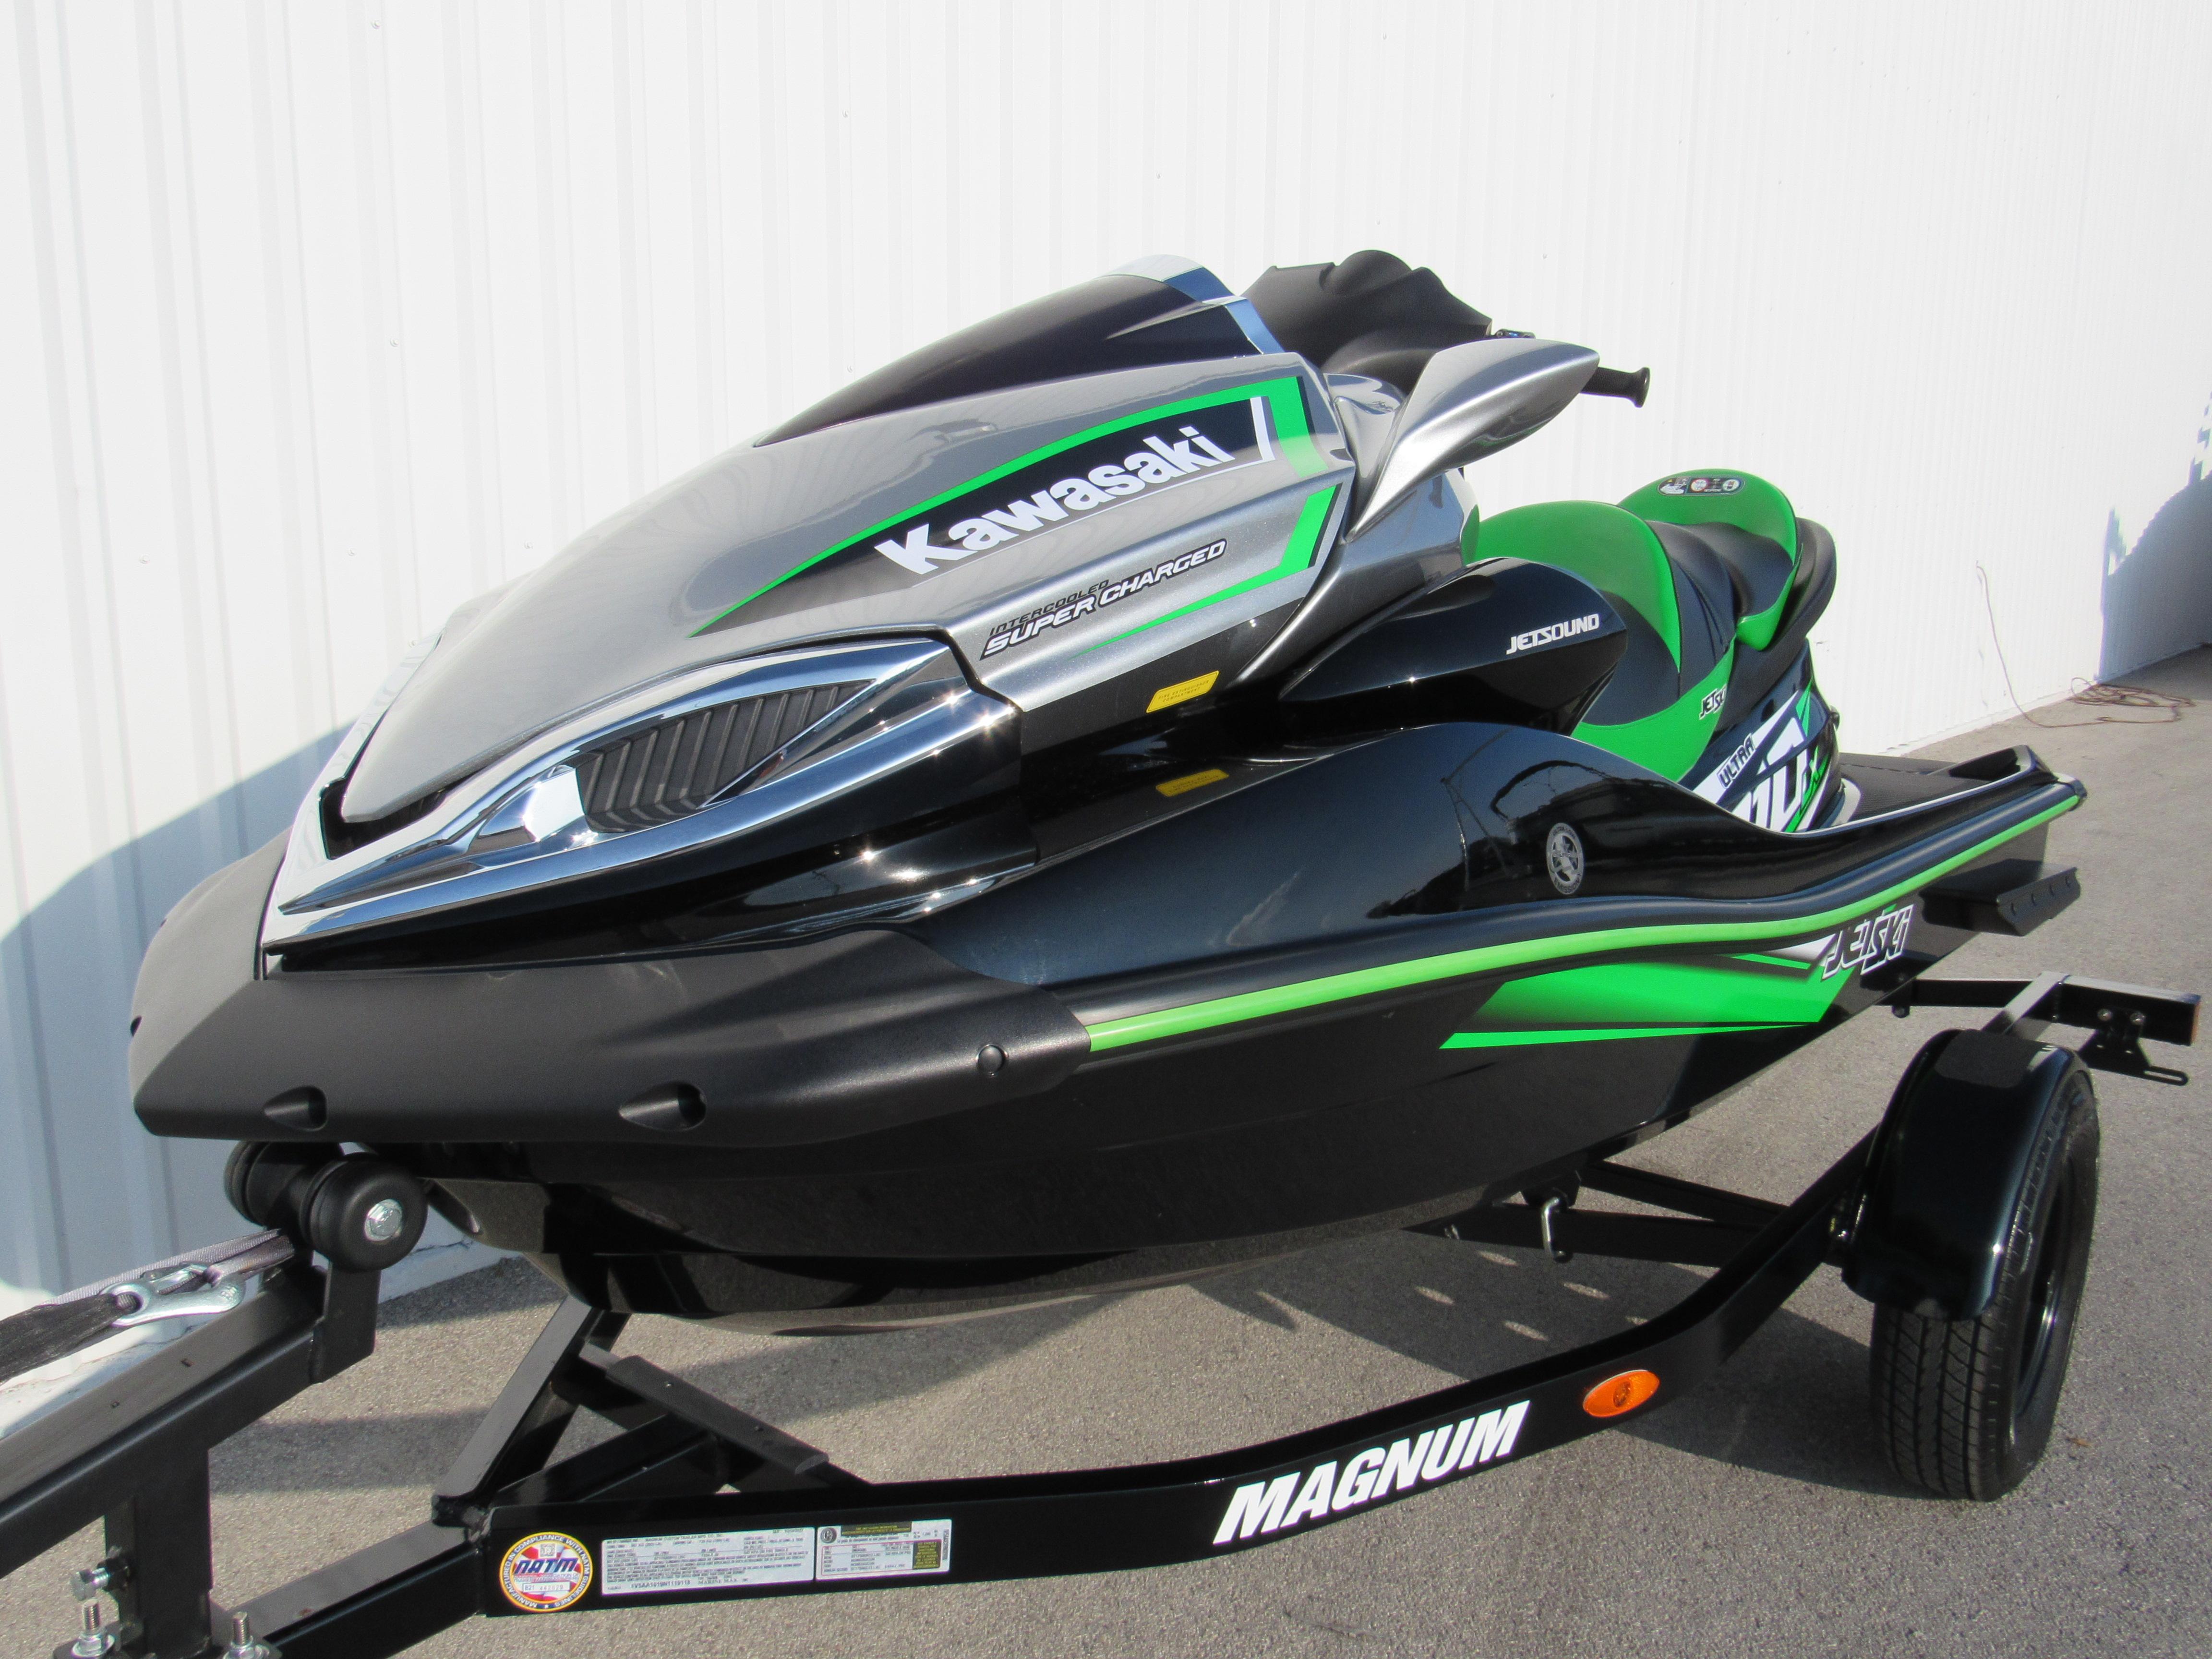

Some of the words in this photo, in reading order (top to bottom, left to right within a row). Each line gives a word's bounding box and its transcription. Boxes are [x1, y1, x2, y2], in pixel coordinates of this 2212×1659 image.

[874, 426, 1236, 575] Kawasaki
[982, 595, 1095, 657] SUPER
[1100, 540, 1226, 606] CHARGED
[990, 579, 1109, 637] INTERCOOLED
[1506, 613, 1599, 655] JETSOUND
[1717, 733, 1756, 789] ULTRA
[1213, 1400, 1530, 1545] MAGNUM
[509, 1552, 516, 1561] IN
[515, 1535, 565, 1552] COMPLIANCE
[565, 1539, 583, 1553] WITH
[581, 1553, 590, 1574] NATM
[504, 1561, 538, 1608] MANUFACTURED
[554, 1575, 589, 1607] GUIDELINES
